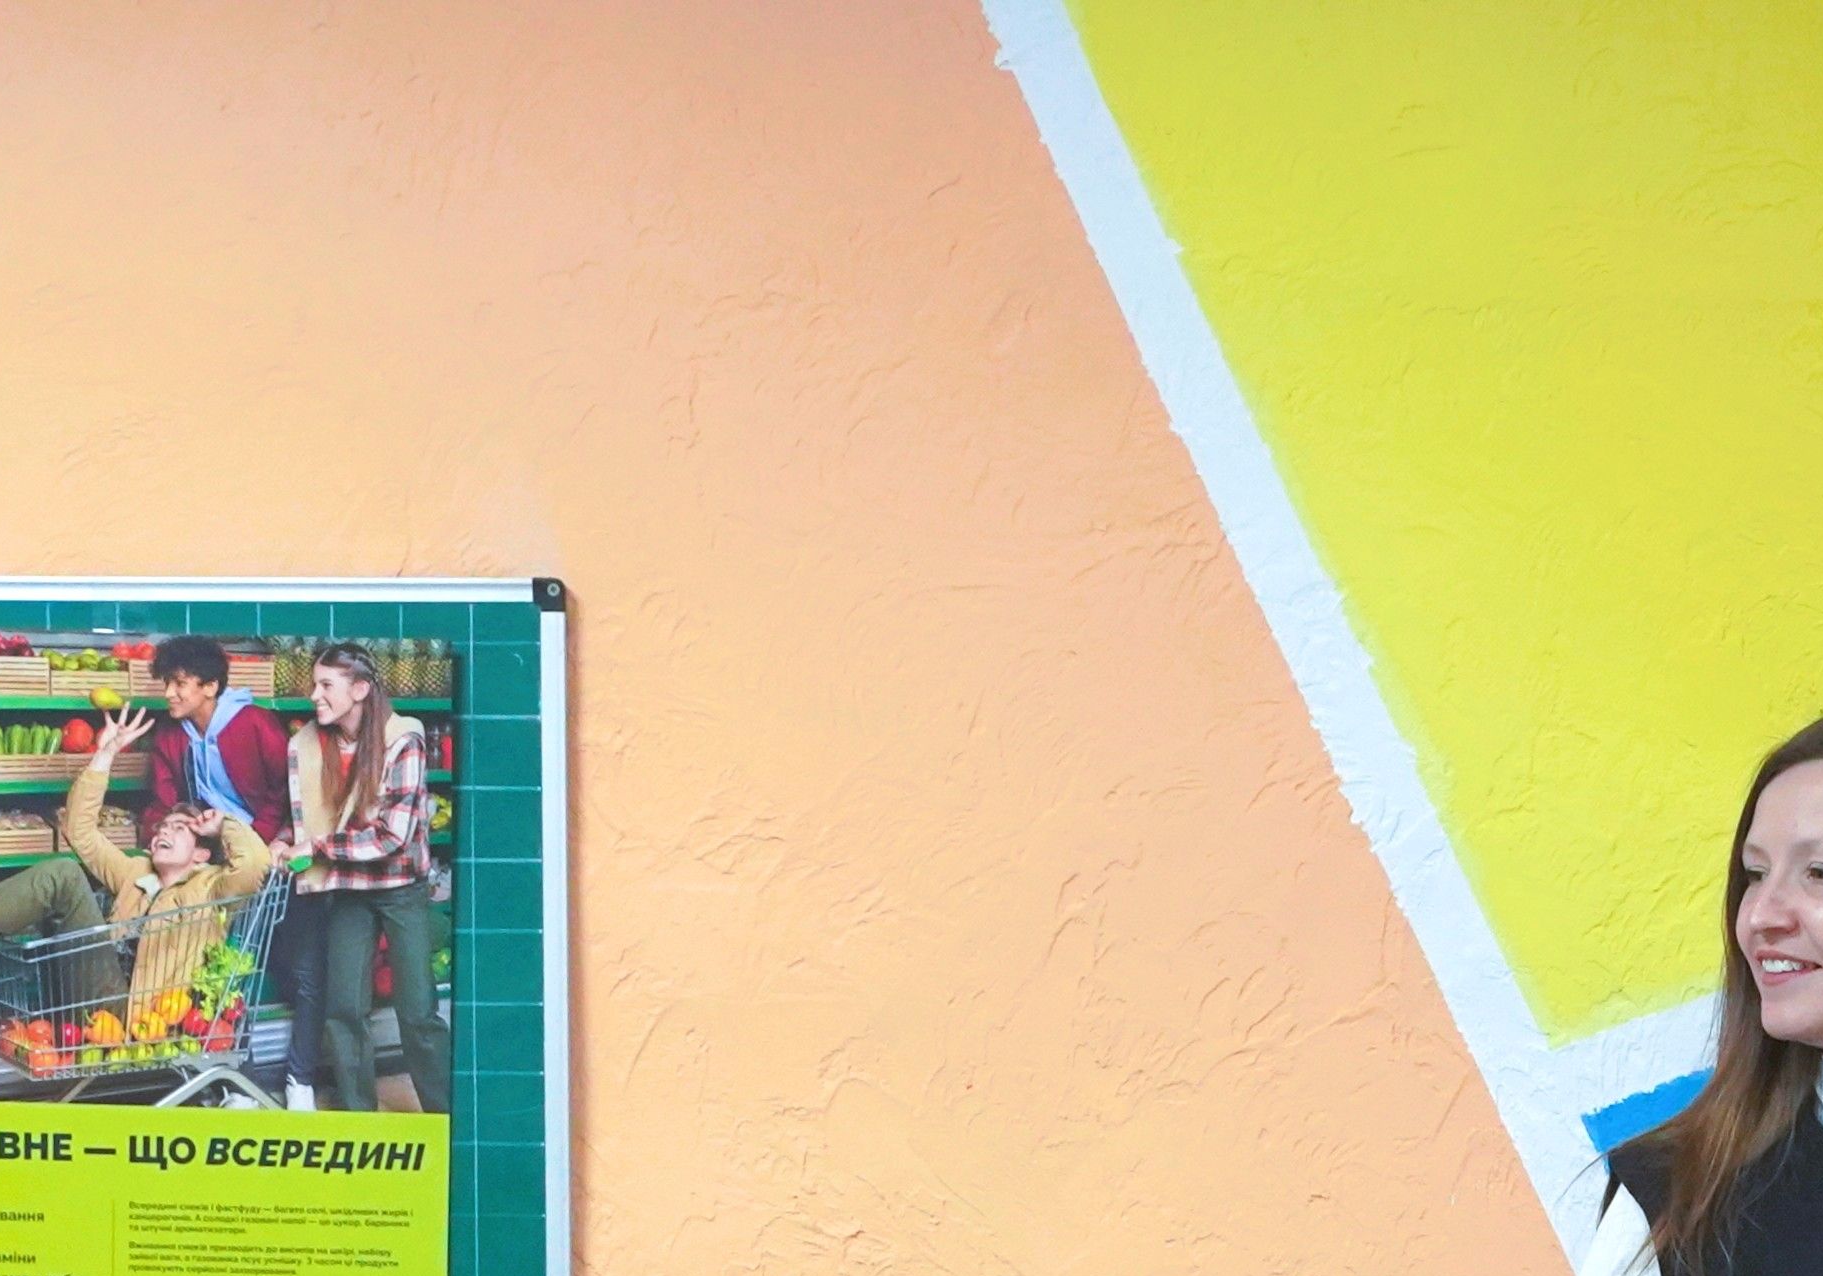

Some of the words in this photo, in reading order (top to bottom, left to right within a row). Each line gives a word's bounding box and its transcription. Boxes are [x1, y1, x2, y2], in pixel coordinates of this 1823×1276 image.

[84, 1147, 116, 1155] —
[129, 1135, 195, 1170] ЩО
[206, 1137, 425, 1174] ВСЕРЕДИНІ
